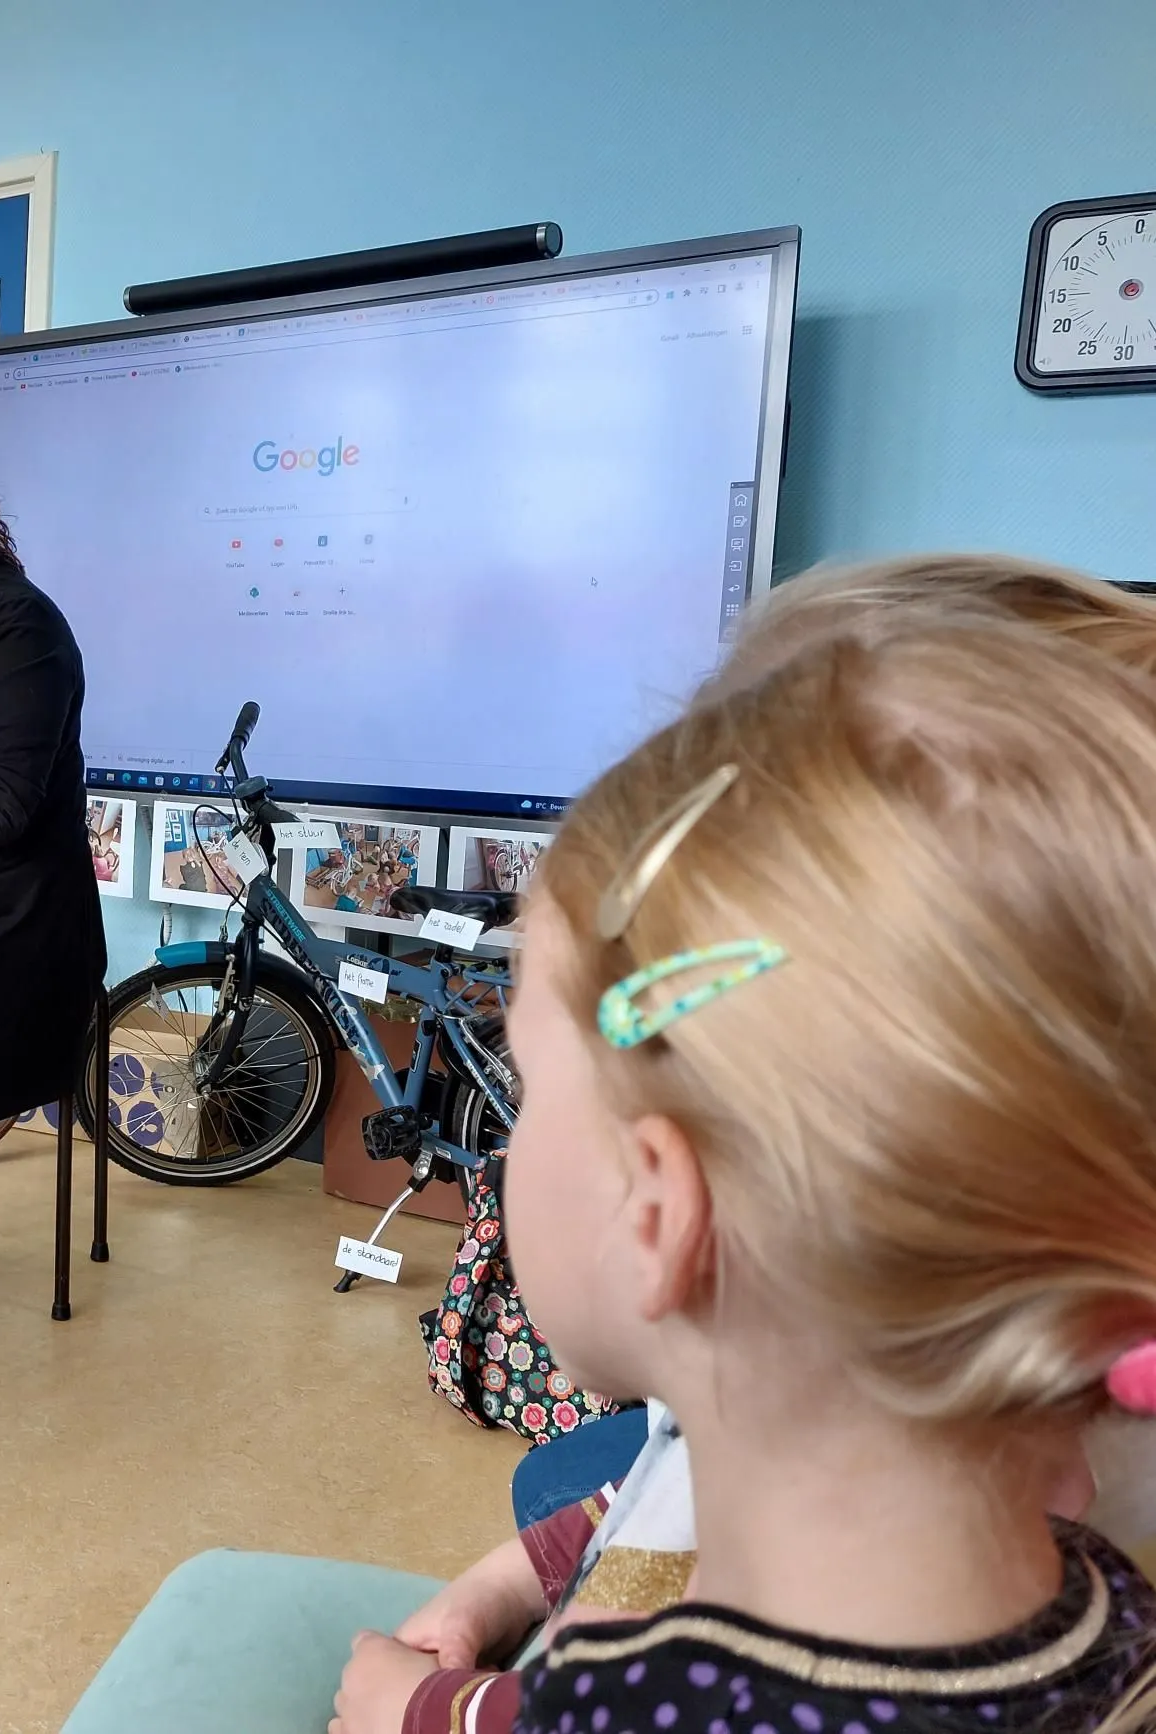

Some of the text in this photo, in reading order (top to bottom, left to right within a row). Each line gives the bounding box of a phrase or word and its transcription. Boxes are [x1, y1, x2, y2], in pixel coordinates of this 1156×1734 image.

[1135, 219, 1145, 234] 0
[1097, 231, 1107, 246] 5
[1062, 256, 1080, 271] 10
[1048, 289, 1067, 304] 15
[1052, 318, 1072, 333] 20
[1077, 340, 1097, 355] 25
[1113, 345, 1134, 361] 30
[253, 435, 360, 477] Google
[535, 802, 547, 810] 8°C
[280, 826, 324, 838] het stuur
[231, 840, 251, 866] de rem
[265, 888, 307, 943] STREETWISE
[428, 917, 467, 934] het zadel
[344, 968, 355, 982] het
[342, 1242, 399, 1267] de standaard
